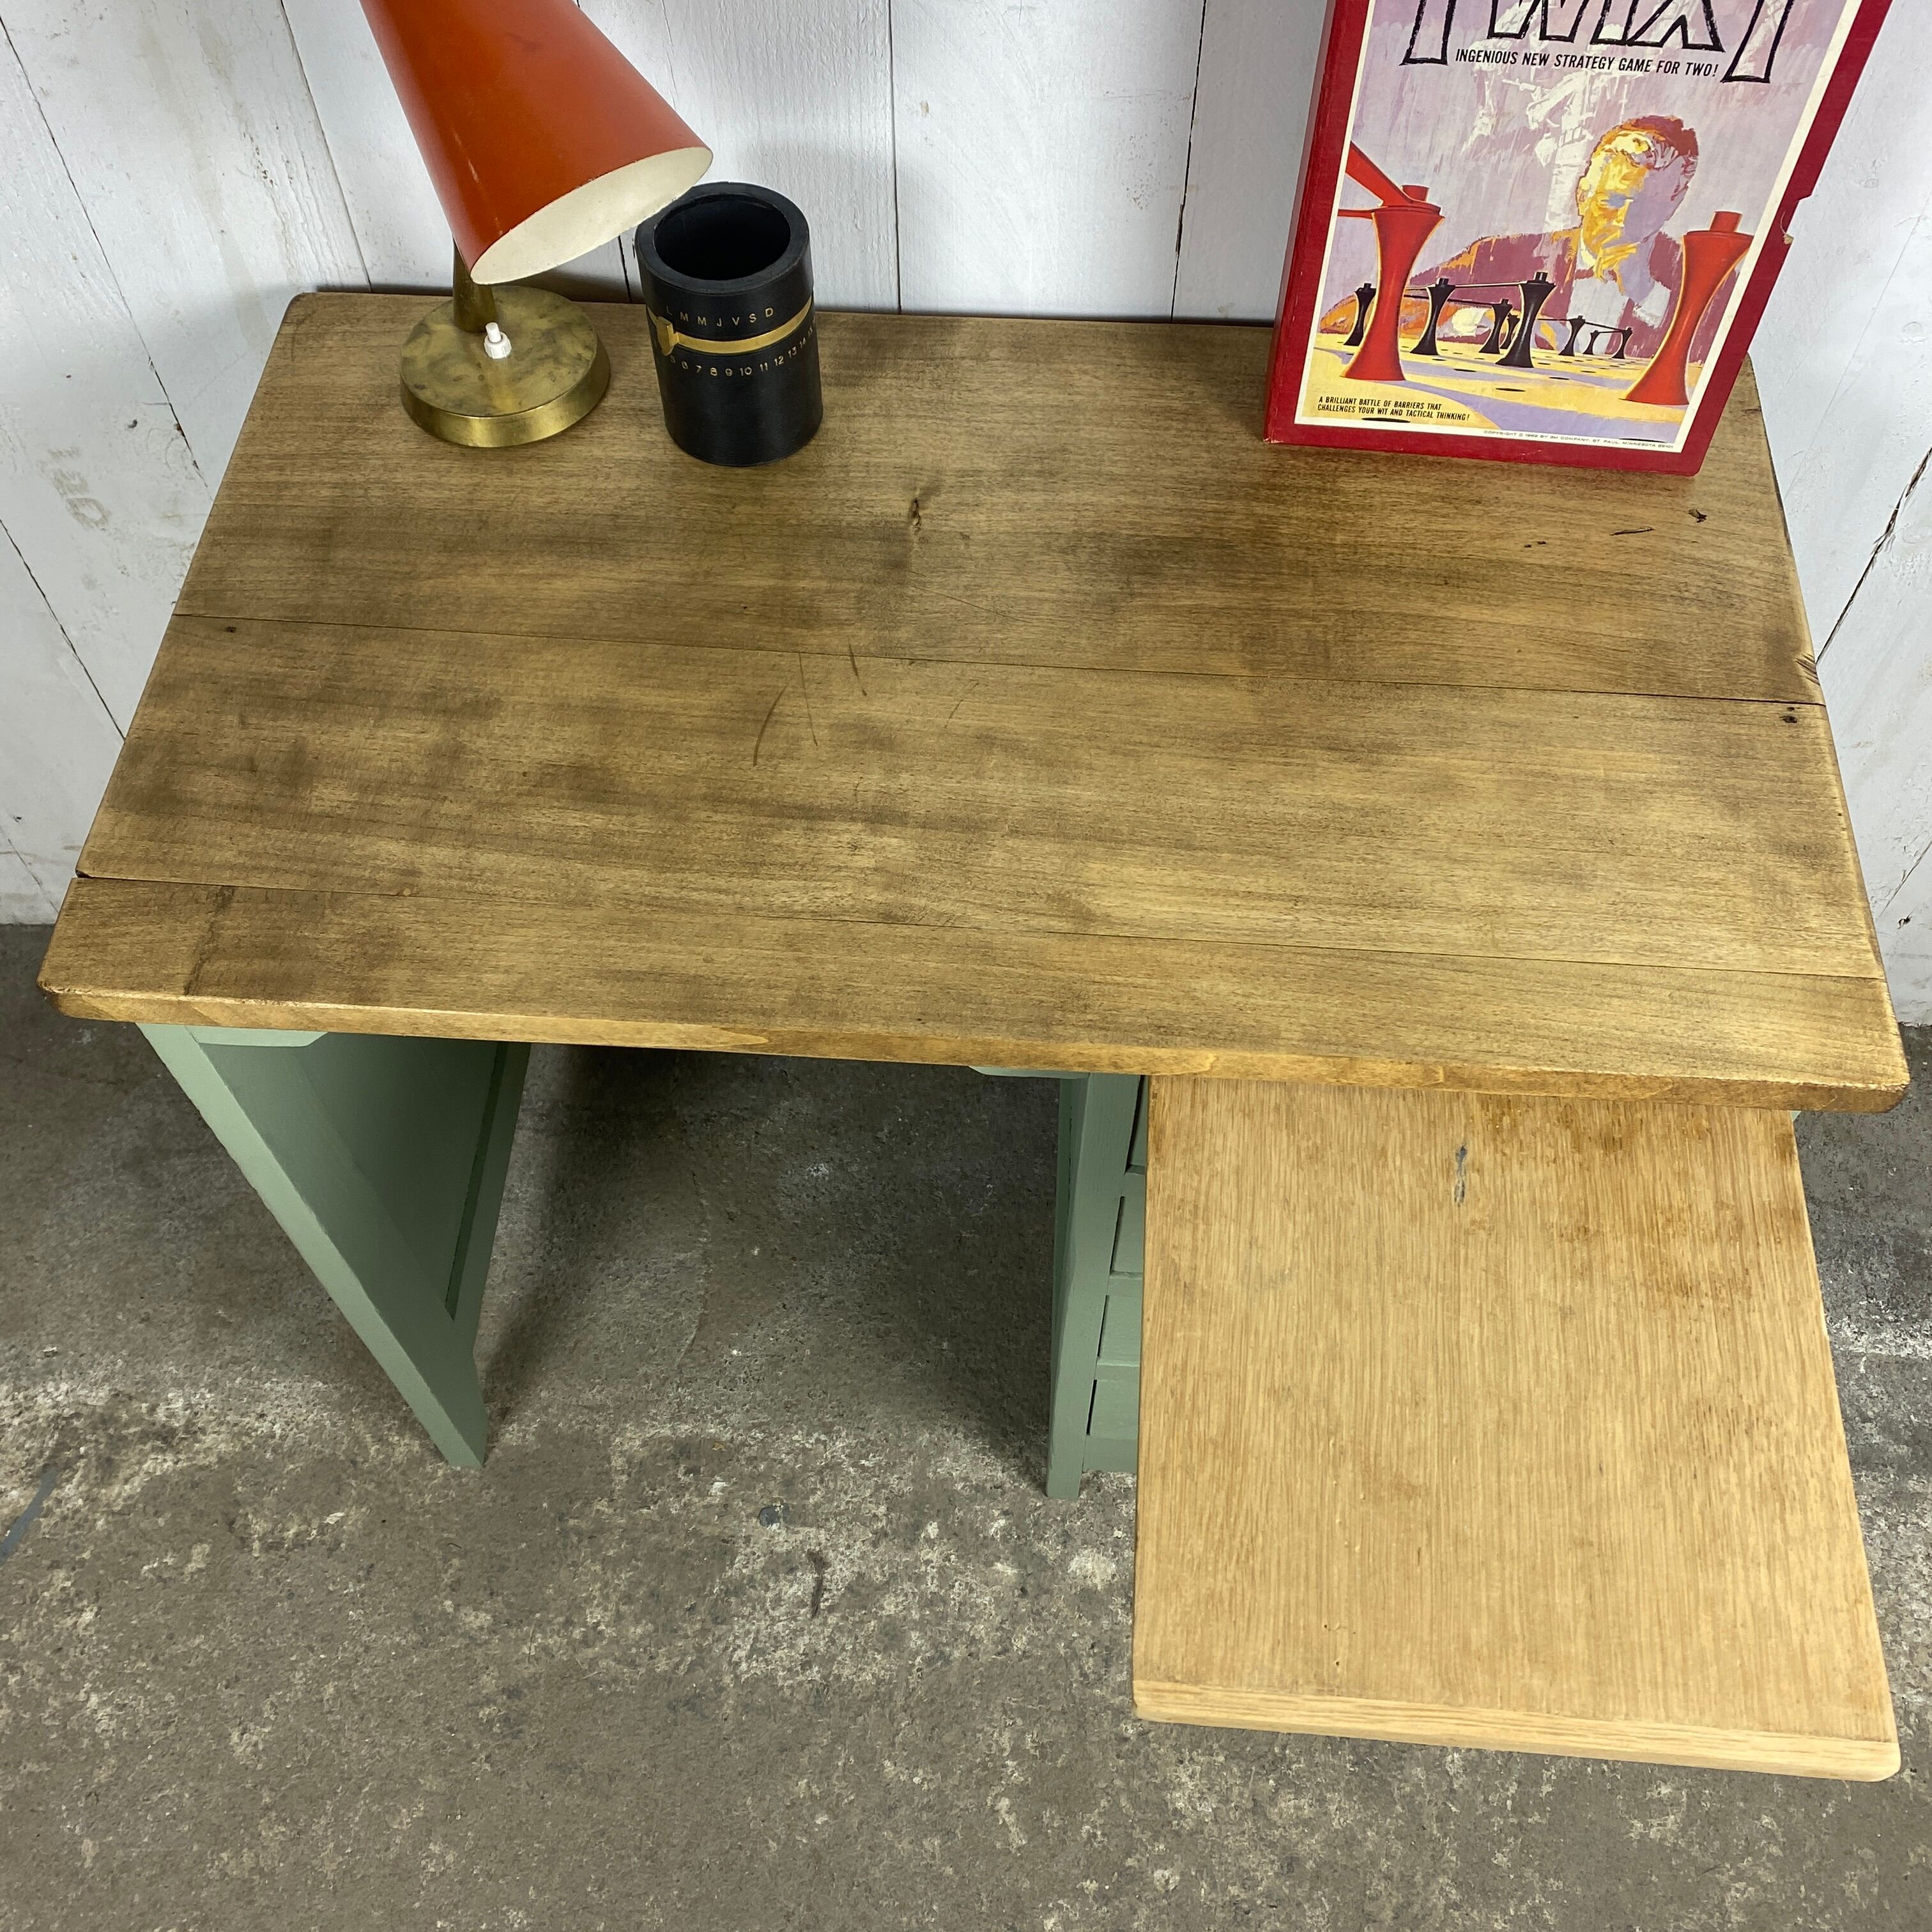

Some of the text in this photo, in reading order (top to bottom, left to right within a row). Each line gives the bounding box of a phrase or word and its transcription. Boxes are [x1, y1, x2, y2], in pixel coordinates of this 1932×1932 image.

[1455, 49, 1719, 77] INGENIOUS NEW STRATEGY GAME FOR TWO!
[680, 311, 689, 322] M
[697, 316, 707, 326] M
[716, 318, 722, 326] J
[732, 317, 739, 325] V
[749, 313, 756, 323] S
[765, 307, 773, 318] D
[710, 367, 717, 376] 8
[725, 368, 733, 376] 9
[740, 367, 752, 376] 10
[760, 362, 768, 372] 11
[774, 356, 784, 366] 12
[788, 346, 797, 358] 13
[1317, 404, 1356, 413] CHALLENGES
[1406, 410, 1433, 418] TACTICAL
[1437, 411, 1469, 420] THINKING!
[1326, 396, 1357, 404] BRILLIANT
[1394, 401, 1425, 409] BARRIERS
